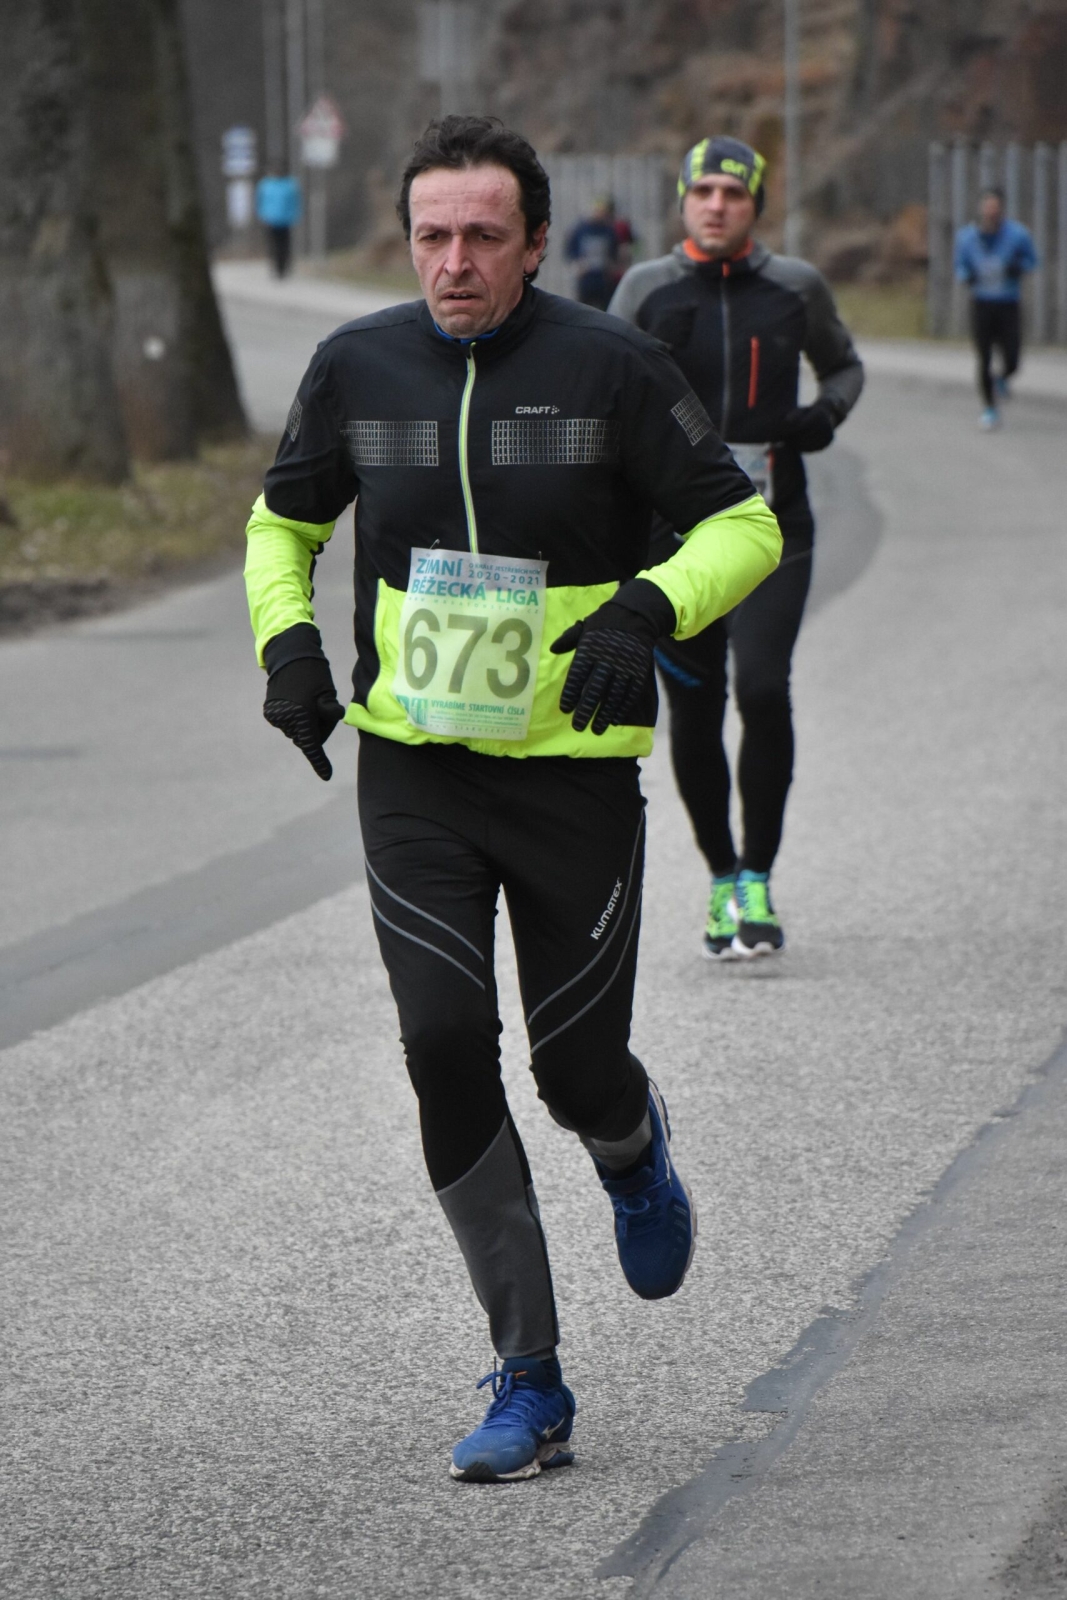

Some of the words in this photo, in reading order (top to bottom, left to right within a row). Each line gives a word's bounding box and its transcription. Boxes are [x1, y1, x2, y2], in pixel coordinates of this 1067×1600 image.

[515, 406, 551, 414] CRAFT
[416, 558, 463, 577] ZIMNÍ
[410, 576, 486, 600] BĚŽECKÁ
[496, 586, 539, 606] LIGA
[404, 608, 533, 699] 673
[468, 702, 505, 715] STARTOVNÍ
[507, 705, 526, 716] ČÍSLA
[590, 879, 622, 940] KLIMATEX
